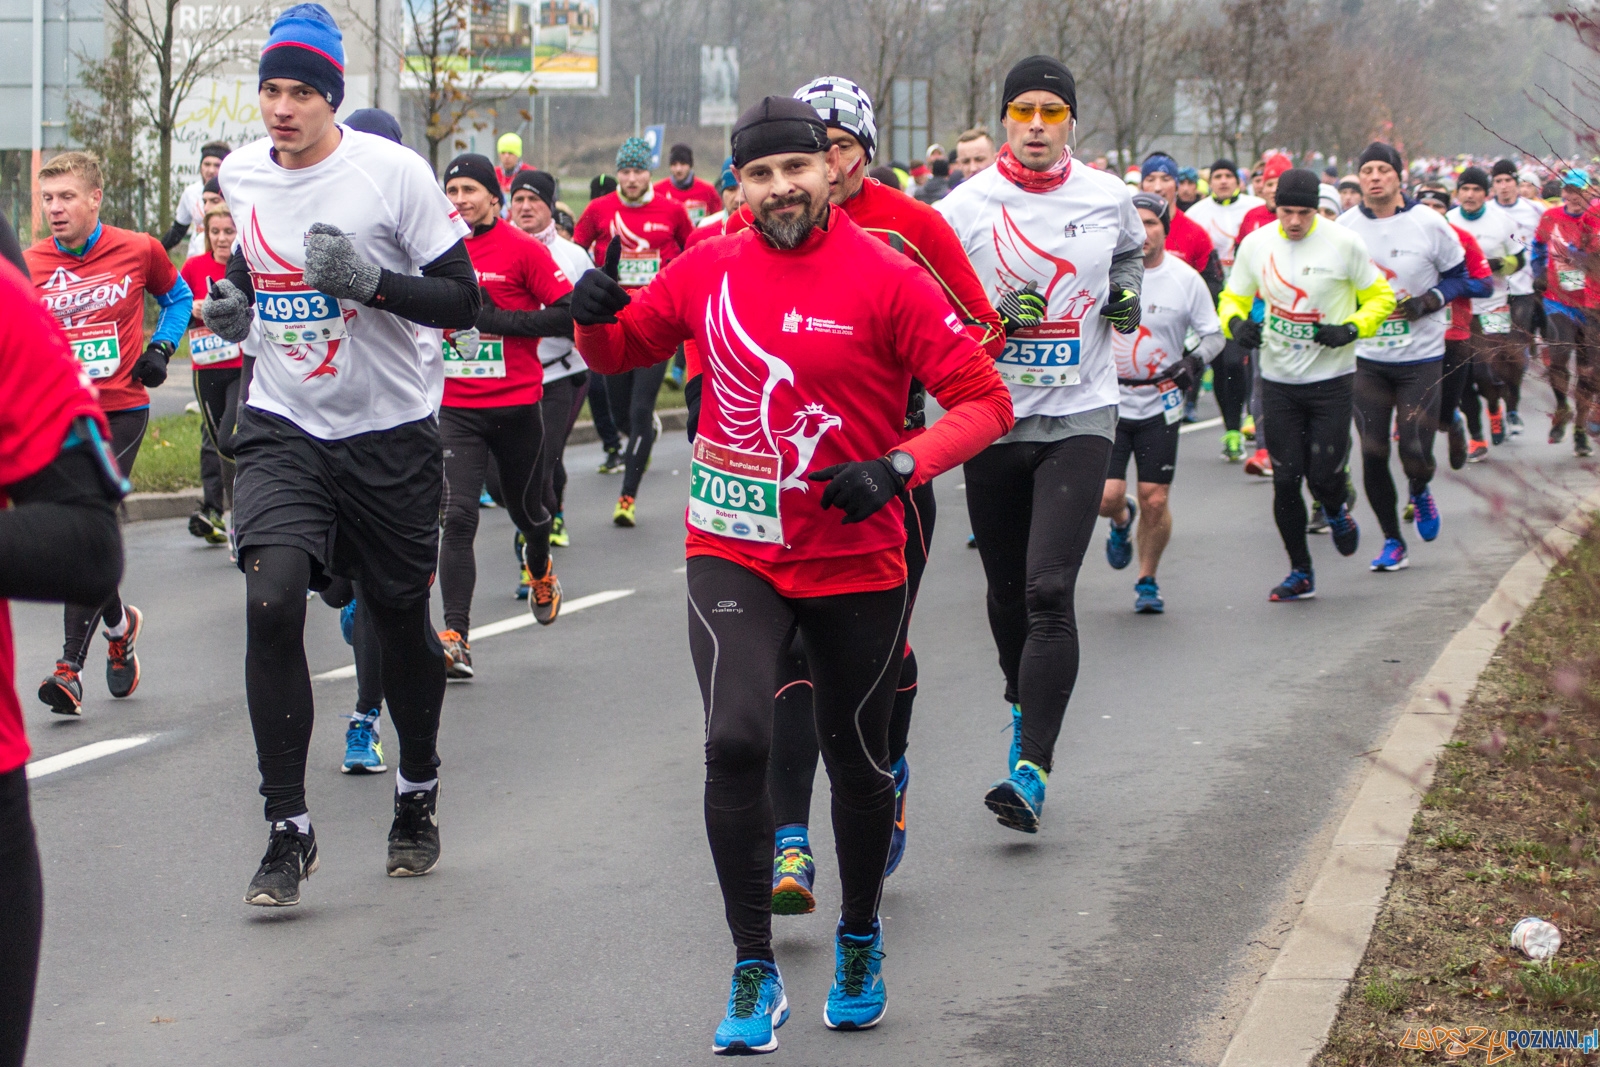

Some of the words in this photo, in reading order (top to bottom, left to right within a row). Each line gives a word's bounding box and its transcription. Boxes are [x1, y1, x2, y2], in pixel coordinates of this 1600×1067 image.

[619, 261, 654, 272] 2296
[265, 295, 329, 320] 4993
[806, 317, 813, 331] 1
[1273, 319, 1315, 339] 4353
[1002, 342, 1072, 365] 2579
[729, 459, 772, 475] RunPoland.org
[691, 475, 697, 485] C
[698, 469, 767, 512] 7093
[715, 509, 738, 520] Robert
